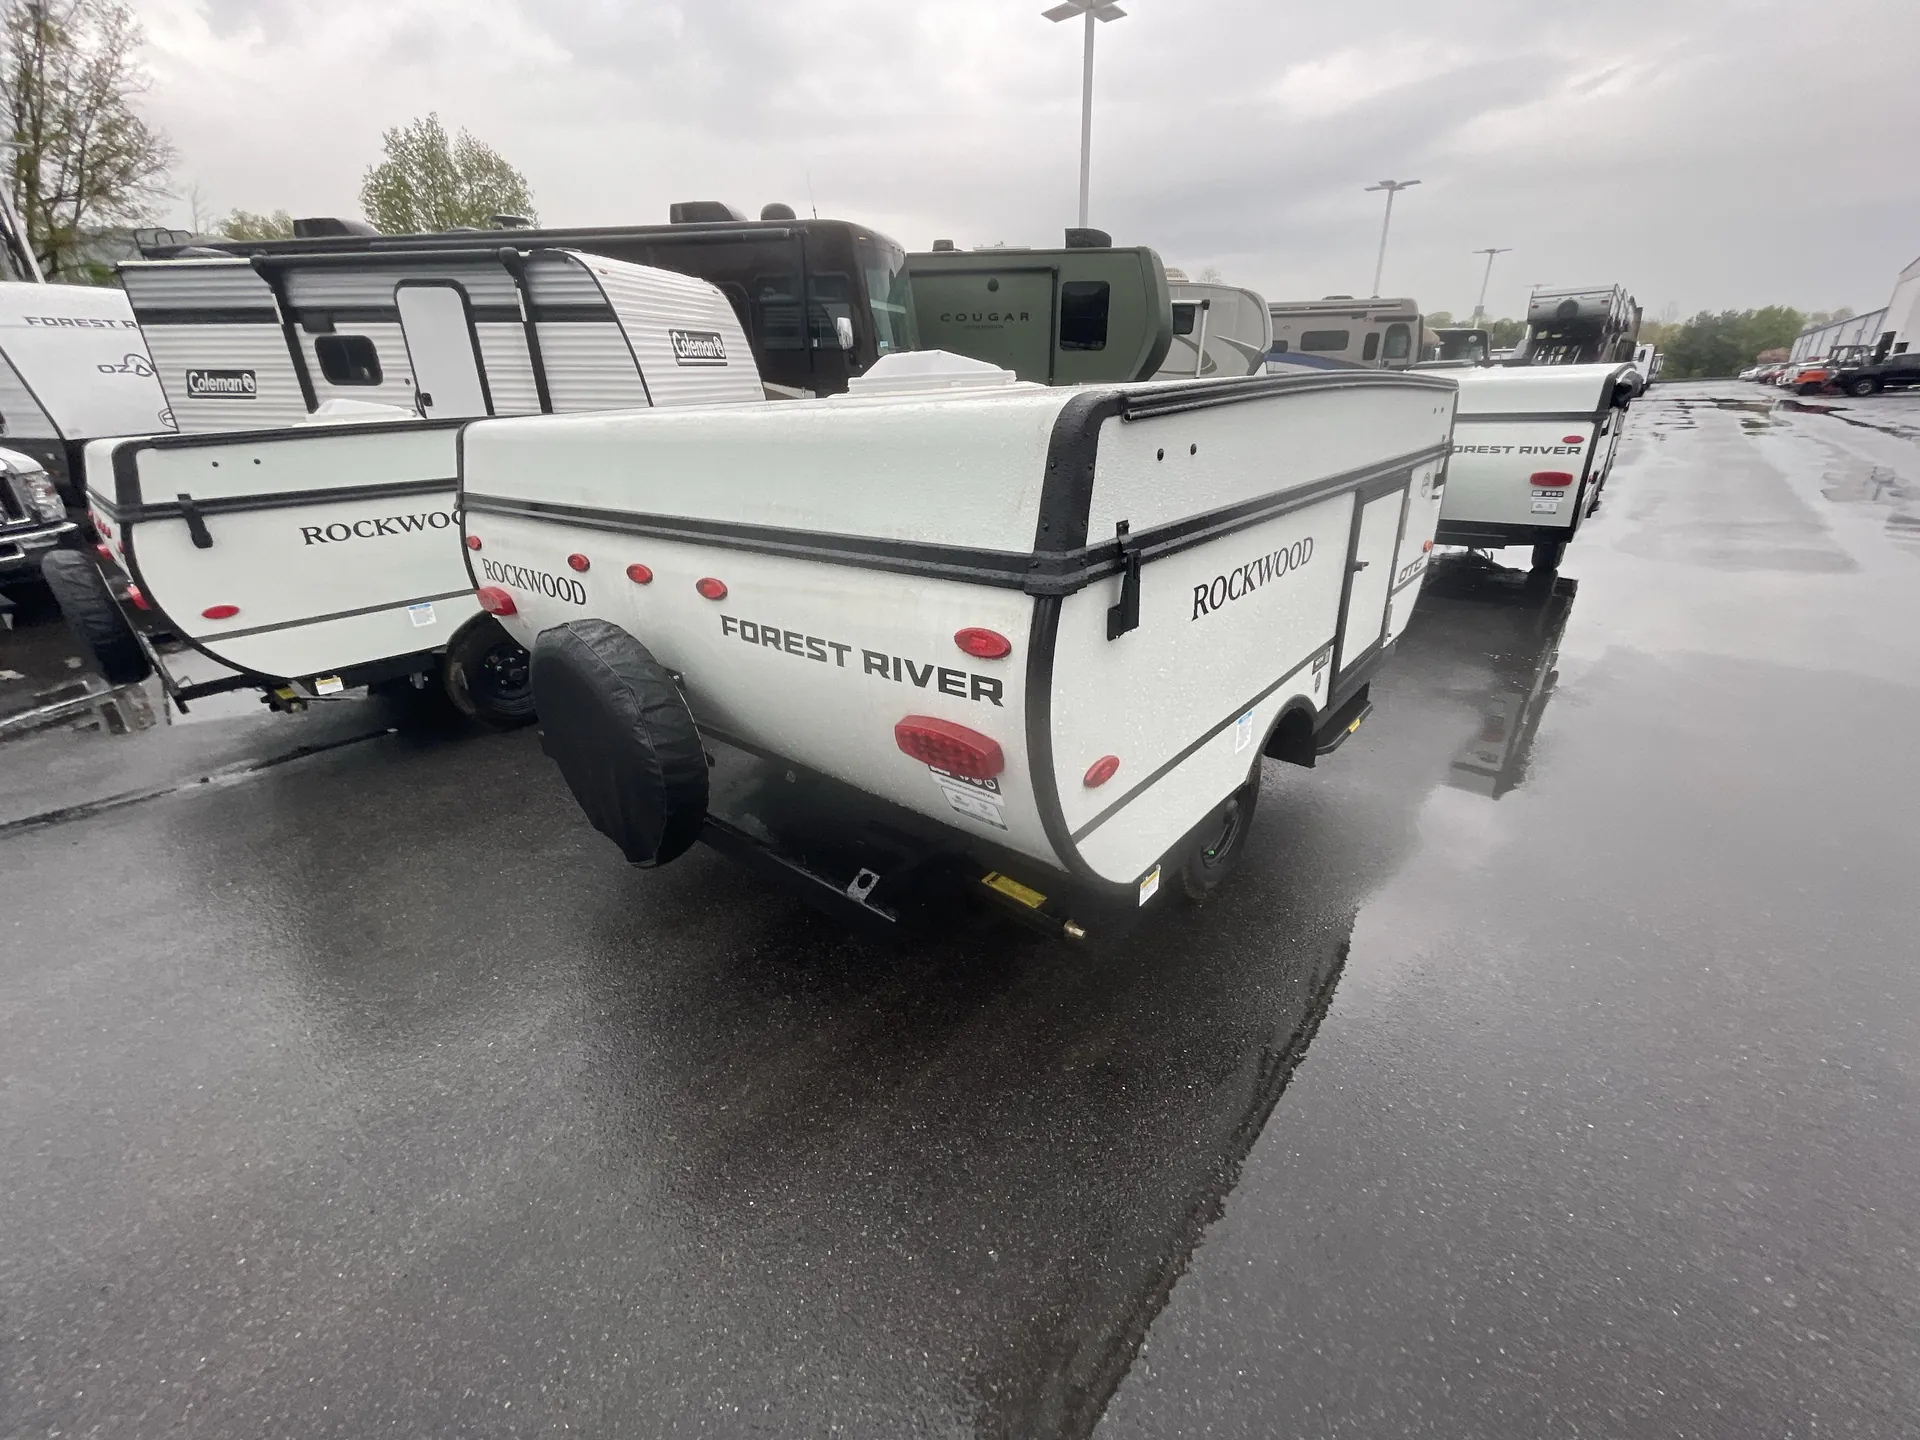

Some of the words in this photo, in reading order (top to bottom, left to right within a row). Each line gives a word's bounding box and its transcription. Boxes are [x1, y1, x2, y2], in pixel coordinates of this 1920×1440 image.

[22, 316, 116, 328] FOREST
[941, 312, 1030, 322] COUGAR
[672, 331, 717, 358] Coleman
[97, 359, 154, 377] OZA
[188, 372, 243, 393] Coleman
[1453, 445, 1515, 454] OREST
[1519, 446, 1582, 455] RIVER
[300, 510, 461, 545] ROCKWO
[481, 557, 587, 605] ROCKWOOD
[1192, 536, 1314, 621] ROCKWOOD
[720, 614, 852, 668] FOREST
[861, 648, 1004, 707] RIVER
